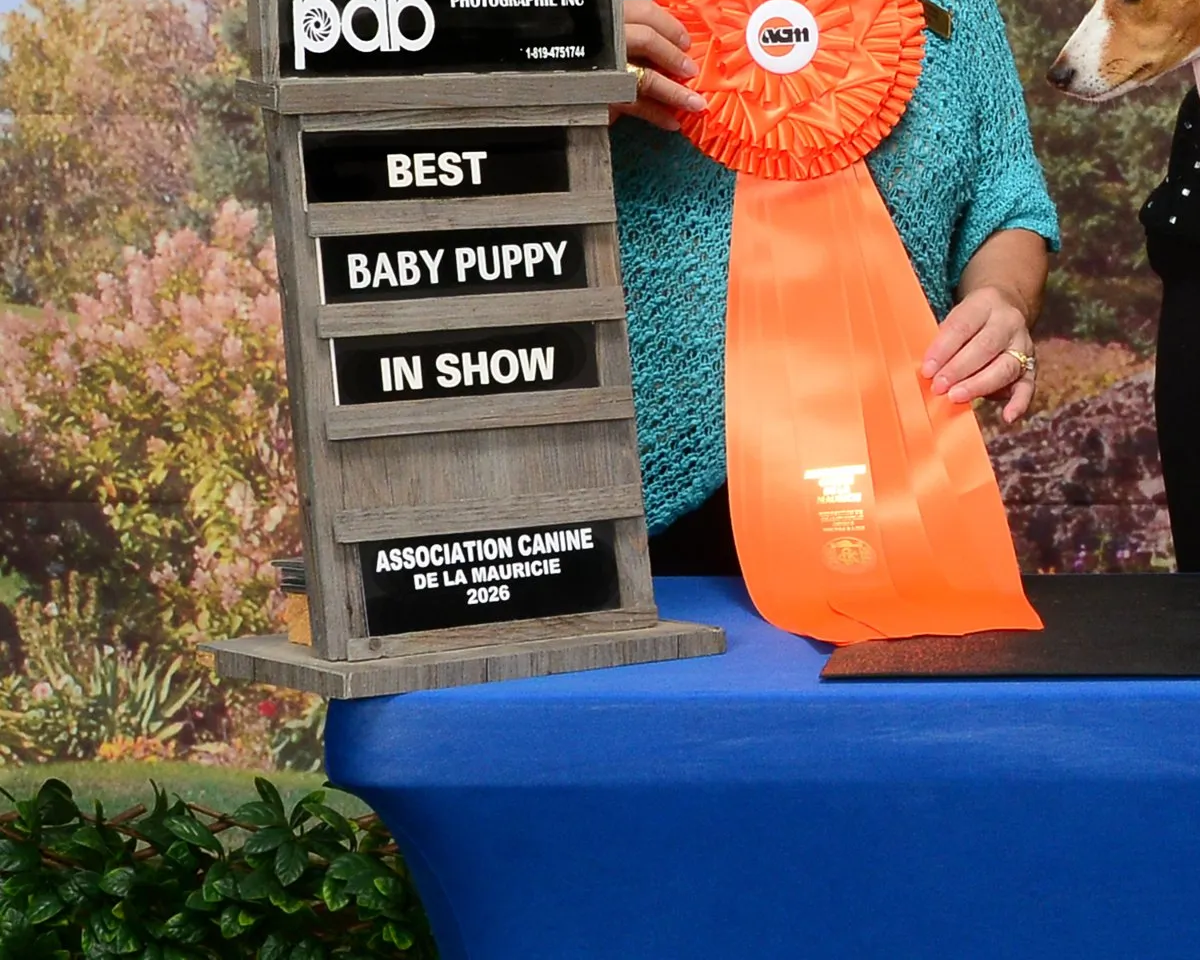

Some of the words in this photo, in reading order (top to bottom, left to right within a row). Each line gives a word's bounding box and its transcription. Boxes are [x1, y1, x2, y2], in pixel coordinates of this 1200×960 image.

[525, 45, 585, 59] 1-819-4751744
[386, 151, 487, 187] BEST
[347, 249, 444, 289] BABY
[455, 241, 567, 282] PUPPY
[380, 355, 423, 391] IN
[435, 347, 555, 388] SHOW
[375, 536, 512, 572] ASSOCIATION
[518, 527, 594, 554] CANINE
[413, 571, 439, 590] DE
[443, 567, 467, 587] LA
[471, 558, 561, 583] MAURICIE
[466, 585, 510, 604] 2026
